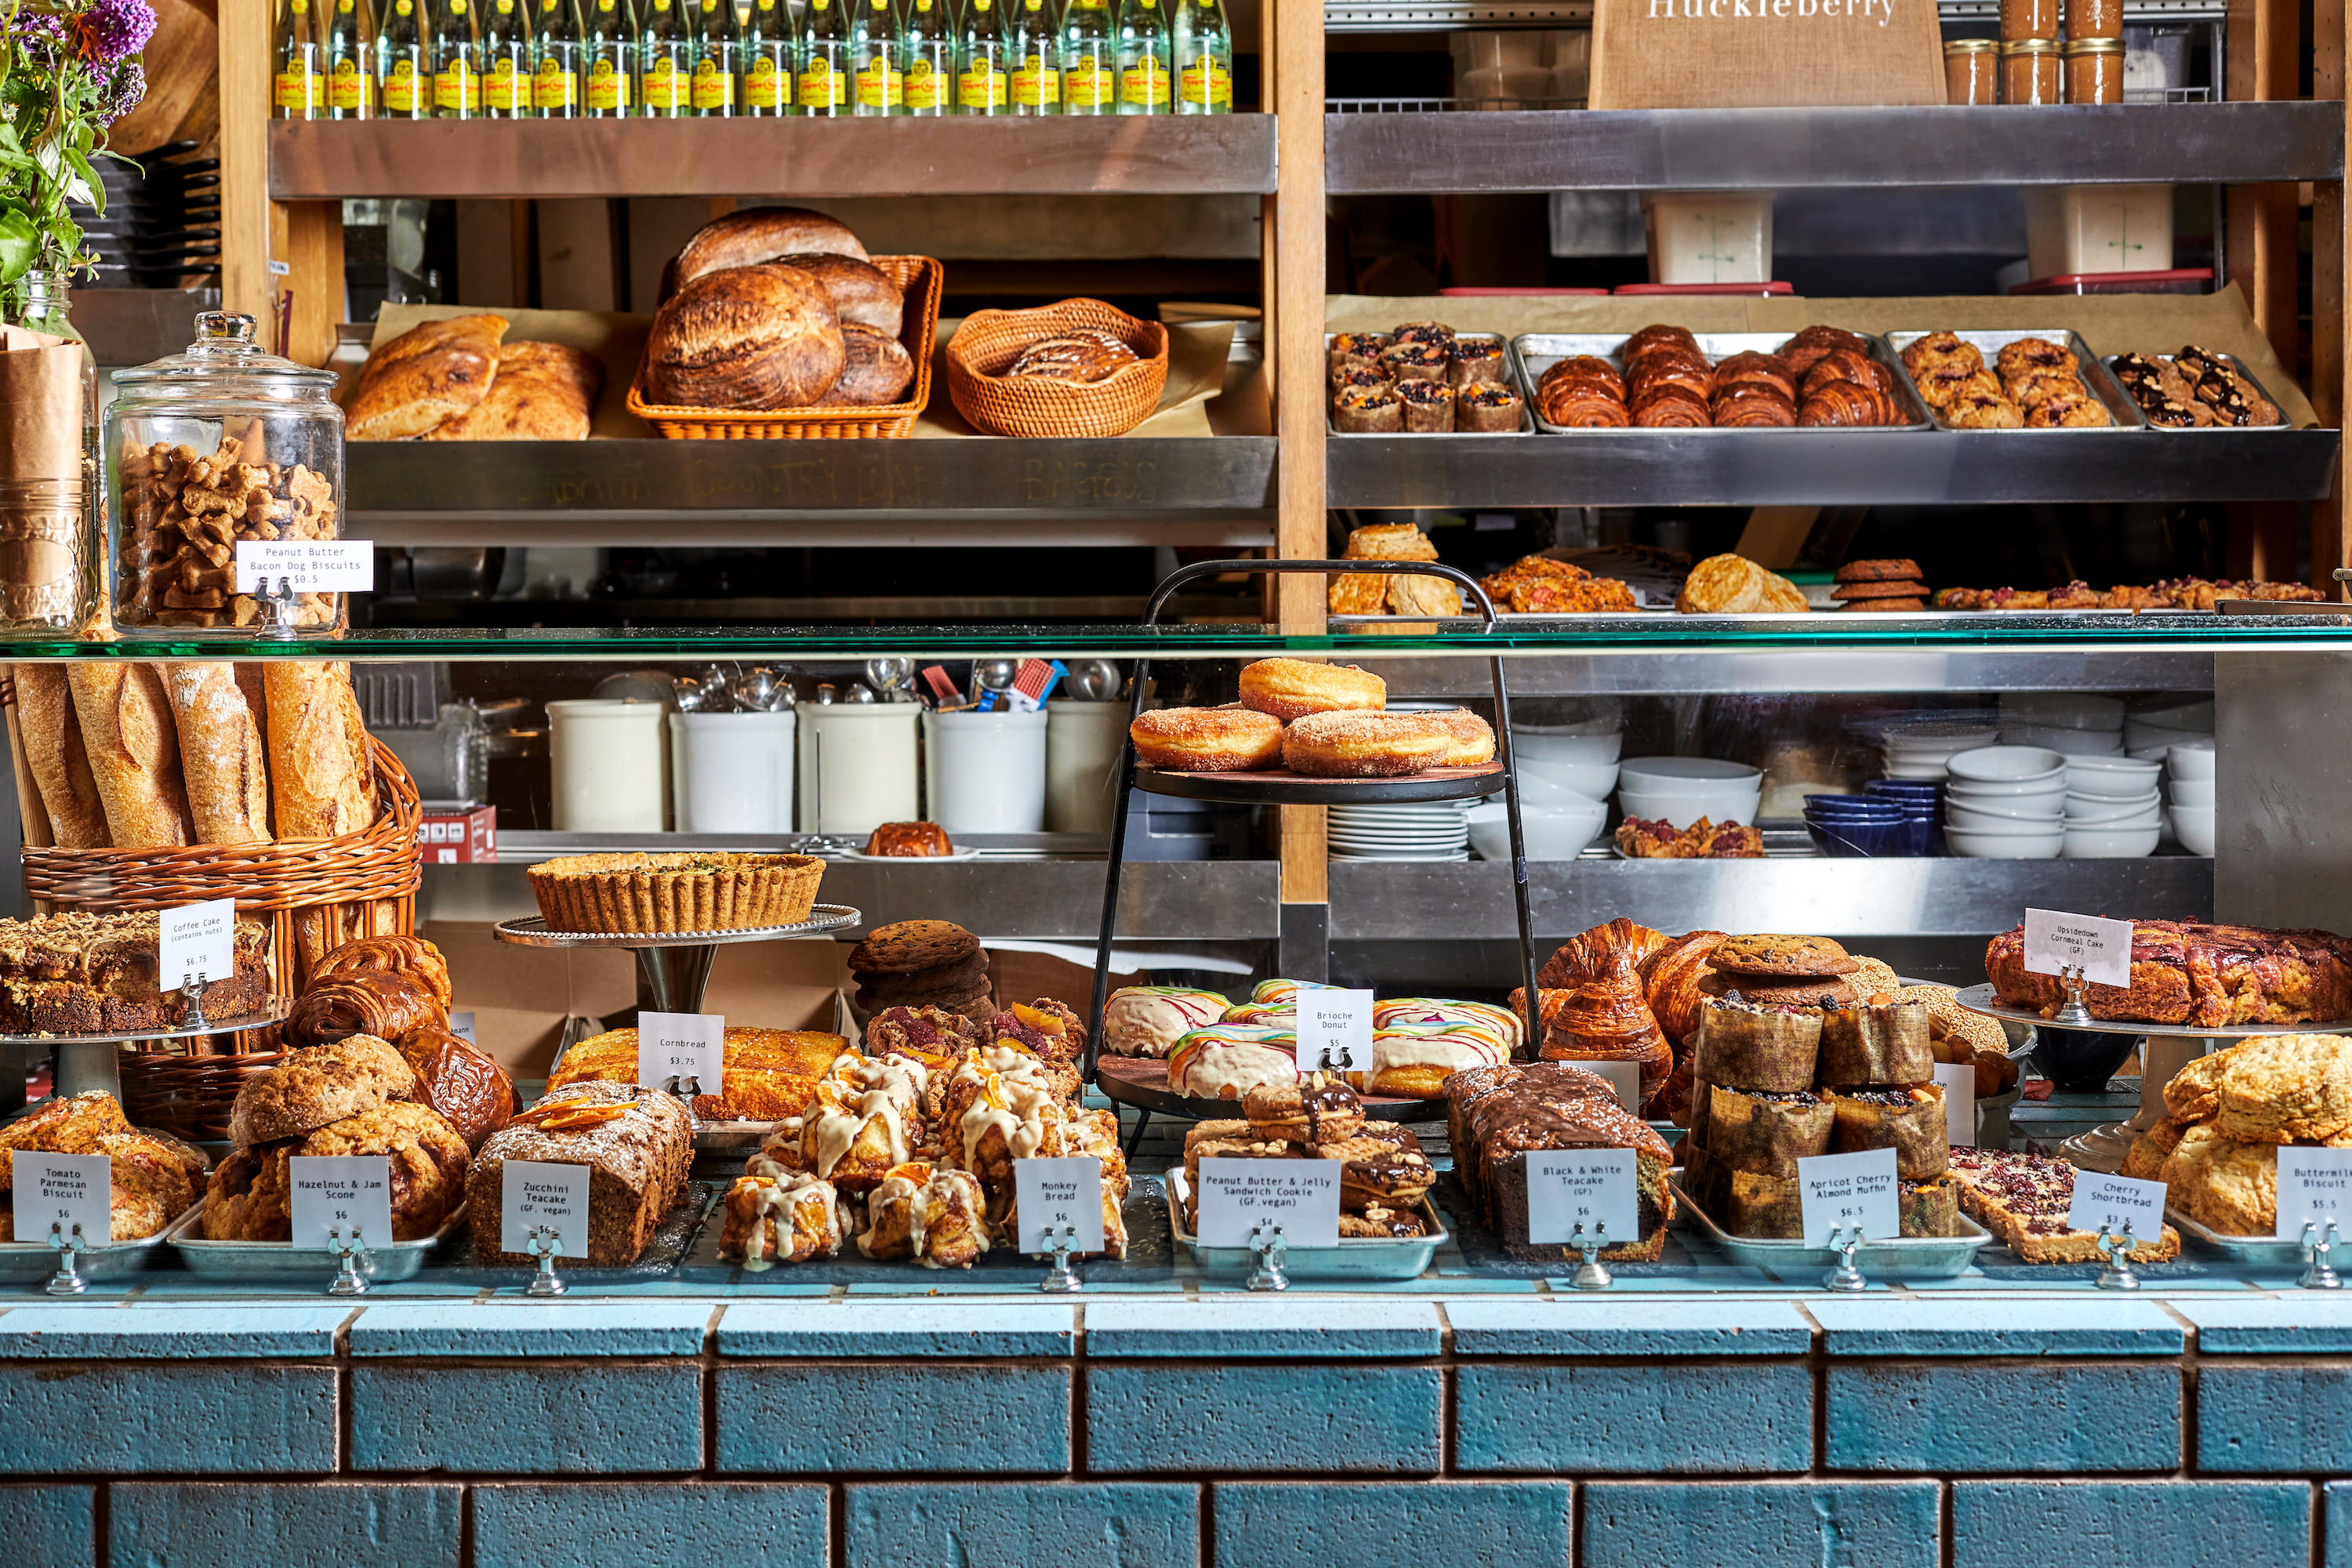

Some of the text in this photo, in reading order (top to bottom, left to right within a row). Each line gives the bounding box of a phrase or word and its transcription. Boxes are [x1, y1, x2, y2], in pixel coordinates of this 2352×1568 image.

[1646, 0, 1894, 27] Huckleberry
[266, 548, 345, 557] Peanut Butter
[288, 561, 306, 572] Dog
[312, 561, 361, 570] Biscuits
[294, 575, 318, 584] $0.5
[173, 918, 220, 932] Coffee Cake
[171, 927, 223, 942] (contains nuts)
[2057, 926, 2099, 938] Upsidedown
[2051, 934, 2103, 949] Cornmeal Cake
[2069, 946, 2085, 956] (GF)
[187, 955, 207, 966] $6.75
[660, 1039, 706, 1048] Cornbread
[670, 1057, 695, 1065] $3.75
[45, 1168, 81, 1178] Tomato
[1543, 1166, 1622, 1176] Black & White
[40, 1178, 86, 1189] Parmesan
[299, 1180, 382, 1189] Hazelnut & Jam
[1206, 1176, 1331, 1189] Peanut Butter & Jelly
[1562, 1176, 1604, 1185] Teacake
[1809, 1174, 1891, 1189] Apricot Cherry
[2303, 1179, 2346, 1188] Biscuit
[524, 1181, 569, 1194] Zucchini
[1042, 1181, 1077, 1191] Monkey
[1224, 1186, 1313, 1196] Sandwich Cookie
[2103, 1182, 2141, 1196] Cherry
[43, 1189, 84, 1199] Biscuit
[1045, 1192, 1075, 1201] Bread
[1573, 1188, 1592, 1196] (GF)
[1816, 1184, 1886, 1200] Almond Muffin
[526, 1192, 566, 1204] Teacake
[2091, 1192, 2152, 1207] Shortbread
[2313, 1200, 2336, 1208] $5.5
[58, 1209, 70, 1218] $6
[336, 1210, 347, 1220] $6
[543, 1207, 571, 1216] vegan)
[1055, 1212, 1068, 1221] $6
[1577, 1207, 1590, 1216] $6
[1841, 1207, 1864, 1217] $6.5
[1261, 1218, 1272, 1226] $4
[2107, 1214, 2131, 1225] $3.5
[539, 1225, 550, 1234] $6
